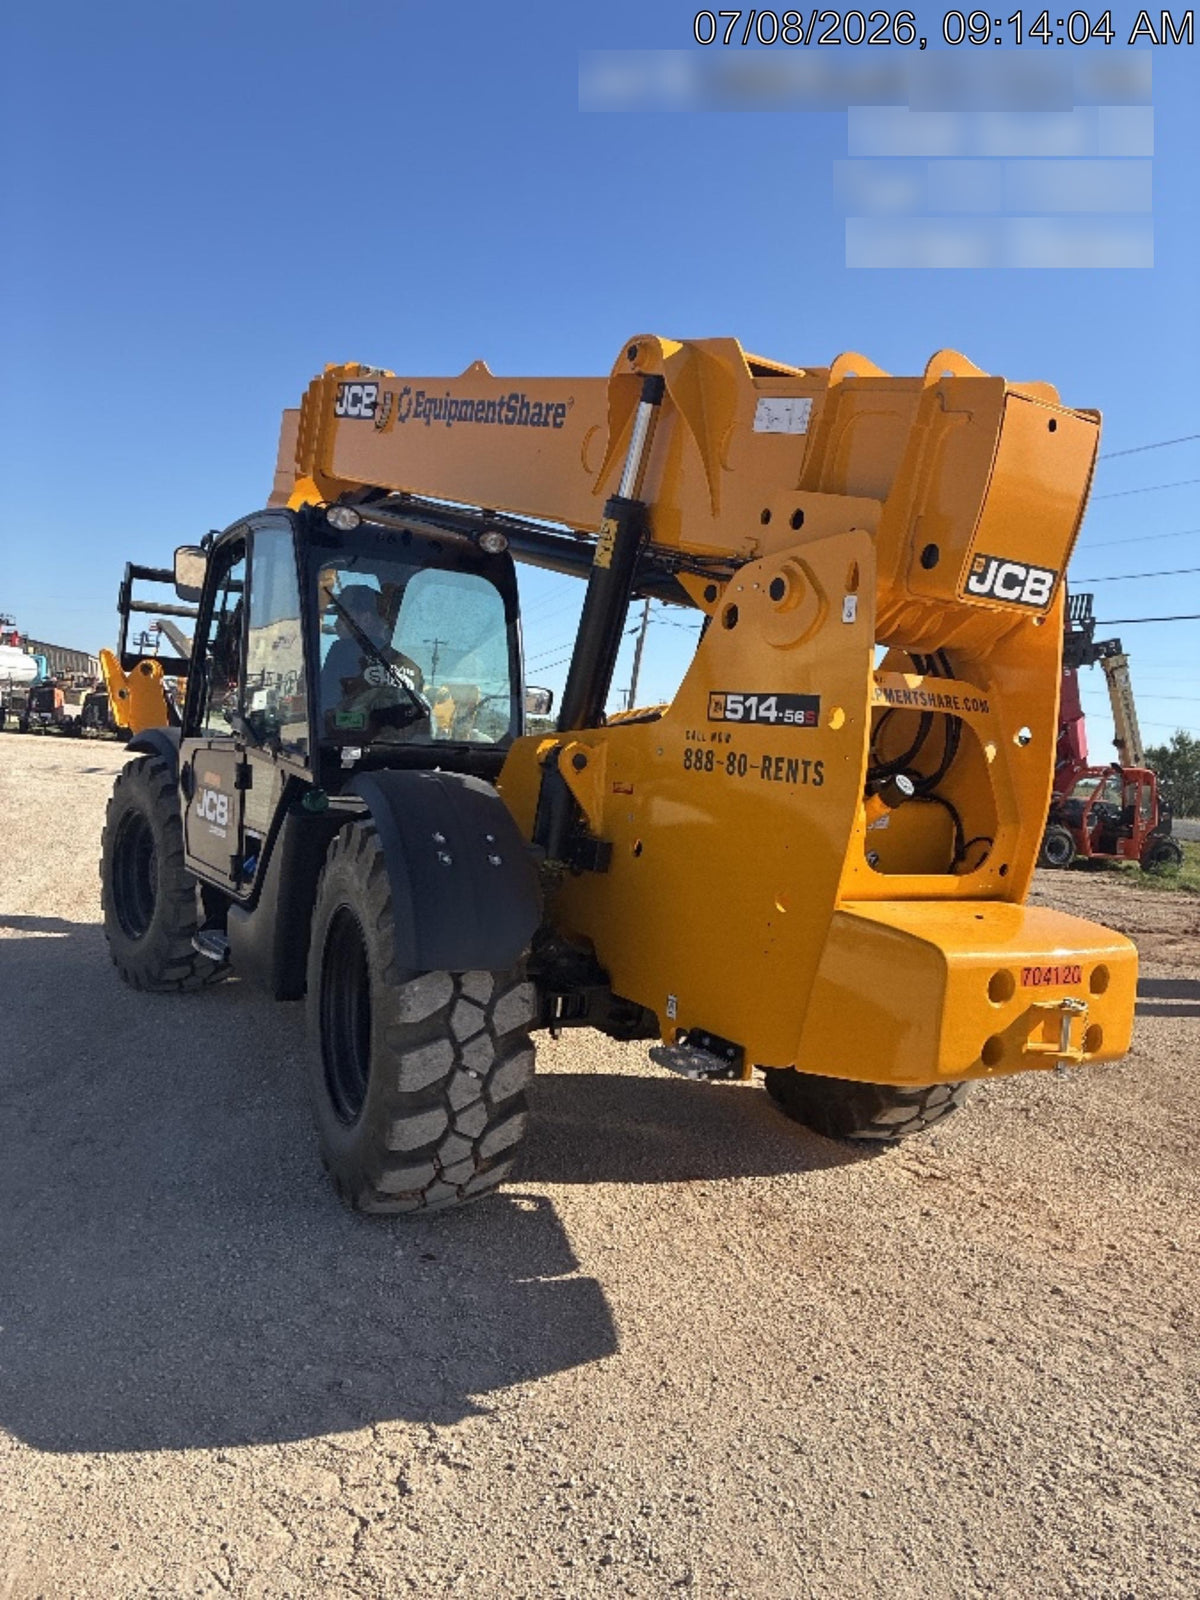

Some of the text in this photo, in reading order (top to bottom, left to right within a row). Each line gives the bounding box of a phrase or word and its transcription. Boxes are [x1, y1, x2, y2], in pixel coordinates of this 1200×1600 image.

[335, 385, 378, 416] JCB
[412, 389, 567, 429] EquipmentShare
[968, 560, 1054, 605] JCB
[873, 687, 989, 714] PMENTSHARE.COM
[683, 747, 824, 787] 888-80-RENTS
[196, 788, 229, 826] JCB
[1023, 965, 1082, 987] 704120
